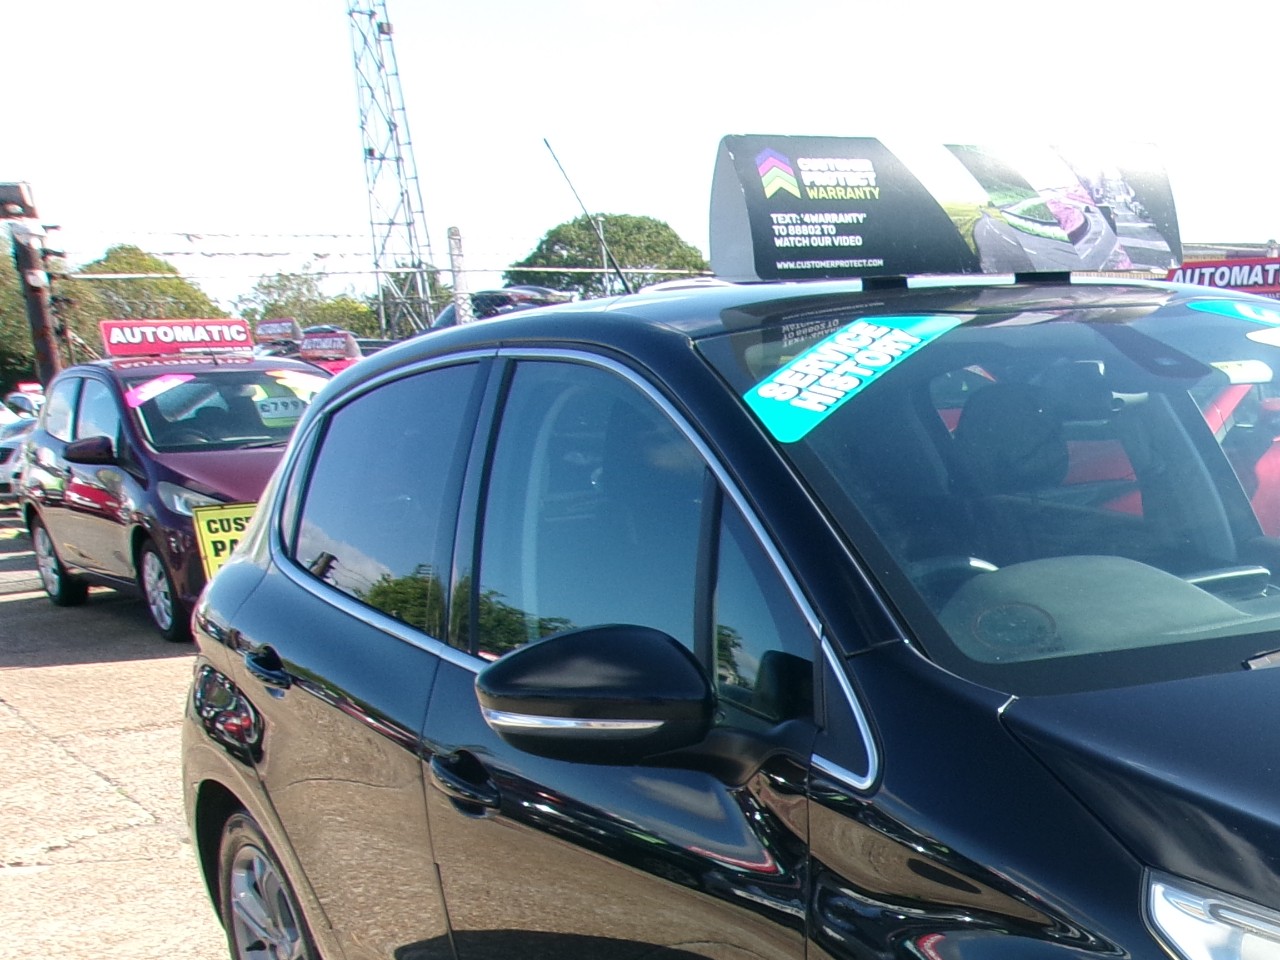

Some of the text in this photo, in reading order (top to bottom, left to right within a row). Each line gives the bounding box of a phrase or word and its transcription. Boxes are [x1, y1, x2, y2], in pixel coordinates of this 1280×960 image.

[801, 171, 876, 186] PROTECT
[805, 187, 879, 199] WARRANTY
[770, 213, 800, 224] TEXT:
[772, 225, 836, 236] TO 88802 TO
[774, 235, 863, 248] WATCH OUR VIDEO
[776, 259, 884, 270] WWW.CUSTOMERPROTECT.COM
[110, 325, 247, 344] AUTOMATIC
[758, 320, 890, 402] SERVICE
[790, 328, 921, 413] HISTORY
[259, 400, 306, 414] £799
